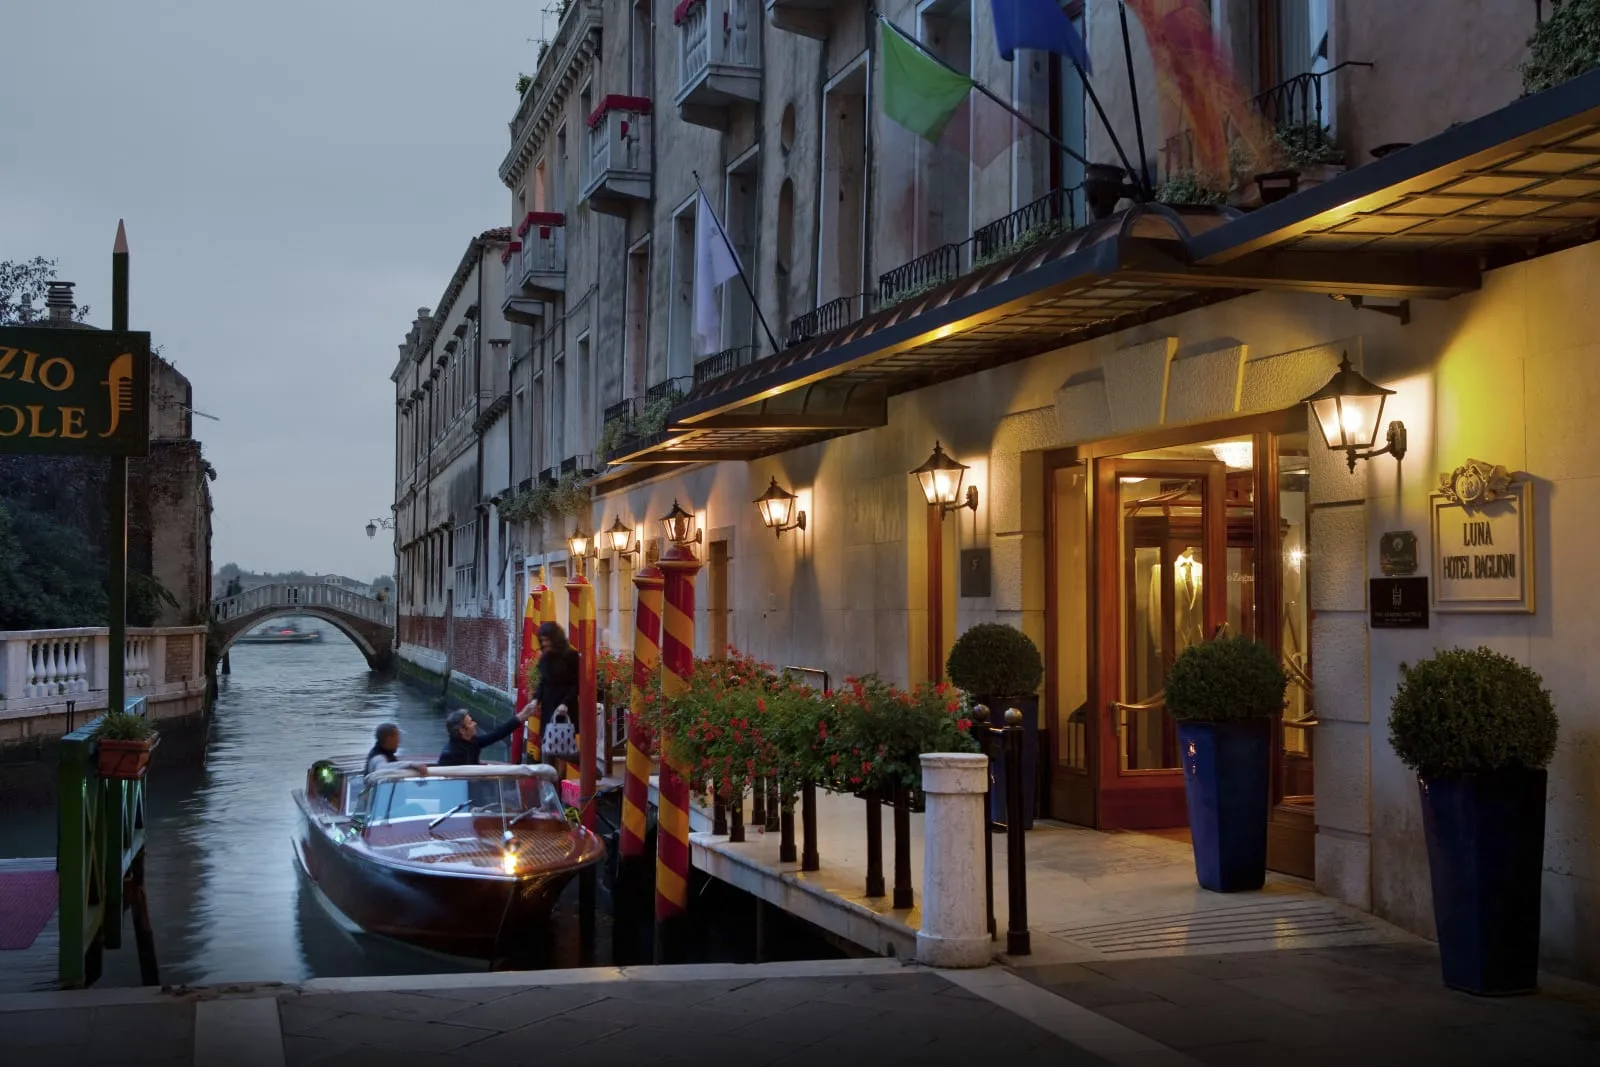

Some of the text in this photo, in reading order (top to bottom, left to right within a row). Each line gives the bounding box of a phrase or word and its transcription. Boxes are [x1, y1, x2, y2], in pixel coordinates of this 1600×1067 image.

[0, 404, 88, 439] OLE
[1463, 521, 1494, 547] LUNA
[1443, 553, 1516, 580] HOTEL BAGLIONI
